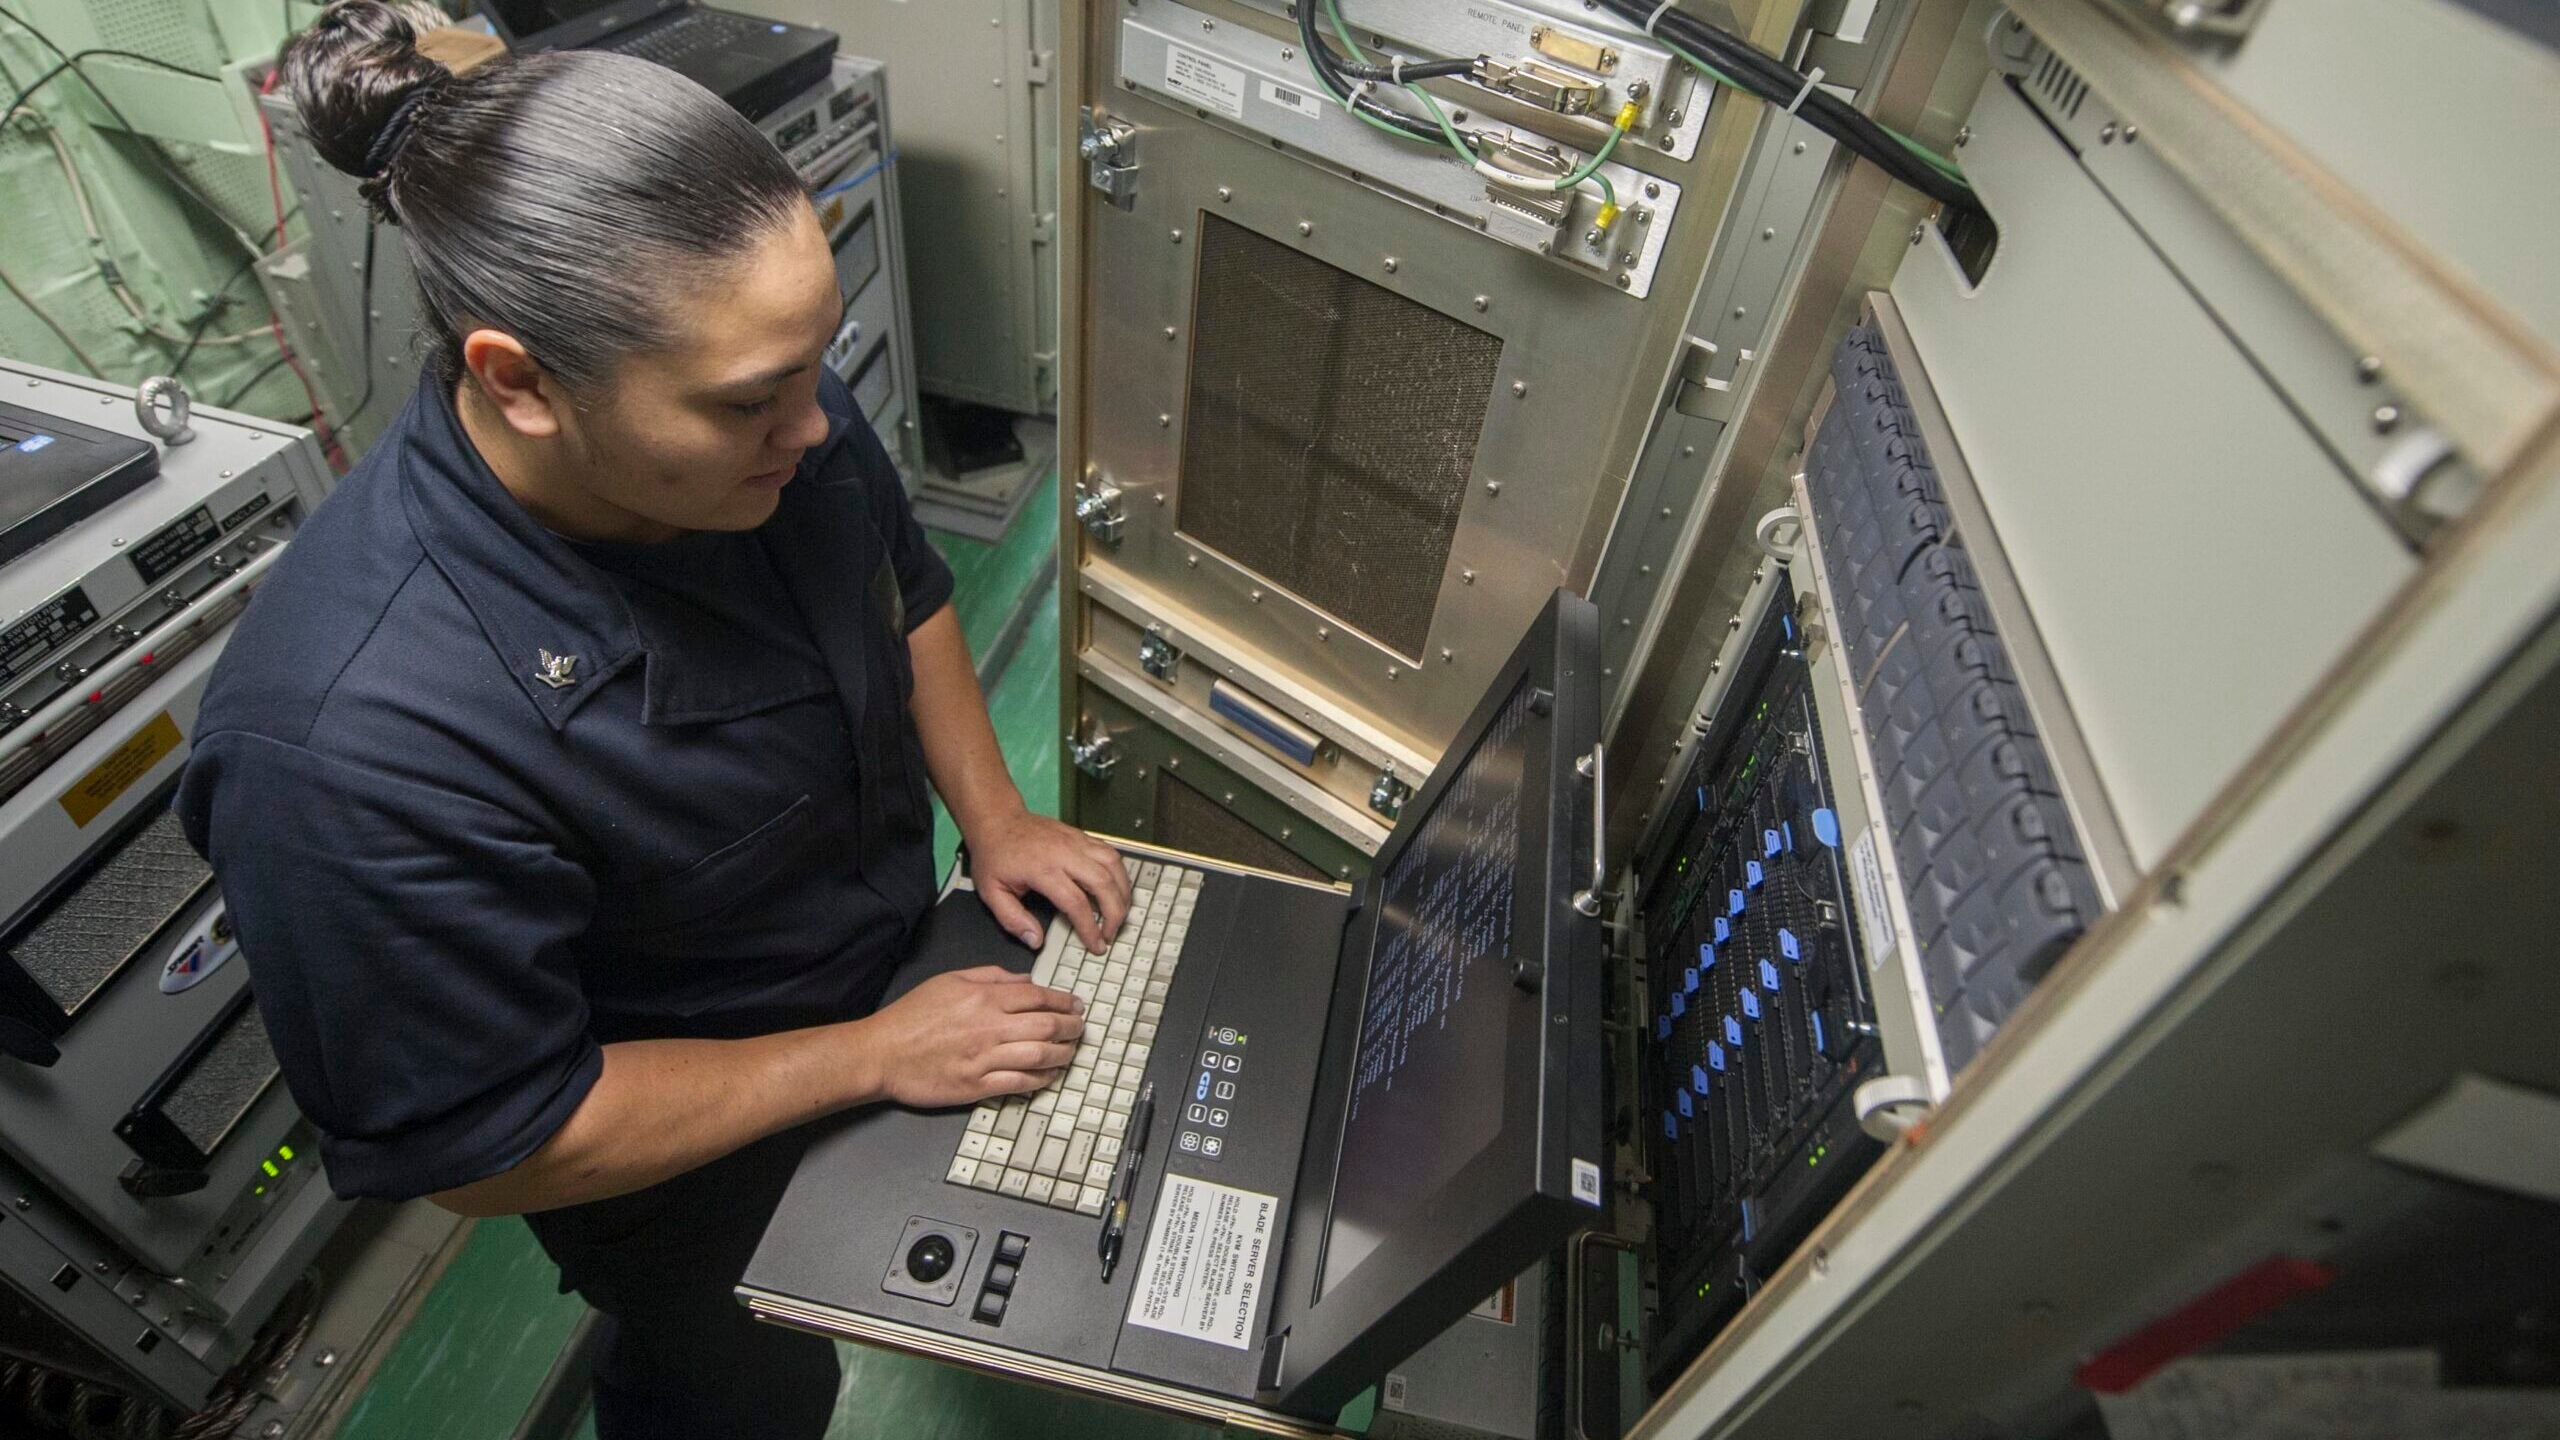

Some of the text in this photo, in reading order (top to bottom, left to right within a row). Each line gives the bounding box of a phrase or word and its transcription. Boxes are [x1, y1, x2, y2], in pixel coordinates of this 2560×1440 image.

[1467, 7, 1527, 35] REMOTE PANEL
[5, 611, 42, 640] SWITCH
[1171, 1183, 1181, 1207] SERVER
[1177, 1185, 1188, 1211] RELEASE
[1186, 1186, 1194, 1202] HOLD
[1217, 1193, 1226, 1219] NUMBER
[1232, 1196, 1240, 1213] HOLD
[1169, 1208, 1175, 1216] BY
[1223, 1195, 1233, 1222] RELEASE
[1161, 1218, 1172, 1245] NUMBER
[1167, 1231, 1176, 1253] STRIKE
[1171, 1234, 1182, 1260] DOUBLE
[1172, 1211, 1199, 1297] MEDIA TRAY SWITCHING
[1207, 1236, 1217, 1257] PRESS
[1213, 1242, 1222, 1267] SELECT
[1219, 1245, 1229, 1271] DOUBLE
[1151, 1263, 1161, 1285] PRESS
[1165, 1262, 1175, 1285] STRIKE
[1224, 1234, 1242, 1294] KVM SWITCHING
[1233, 1202, 1268, 1339] BLADE SERVER SELECTION
[1156, 1270, 1166, 1295] SELECT
[1207, 1268, 1217, 1291] BLADE
[1213, 1273, 1223, 1296] STRIKE
[1150, 1297, 1160, 1318] BLADE
[1201, 1292, 1211, 1319] SERVER
[1199, 1321, 1205, 1330] BY
